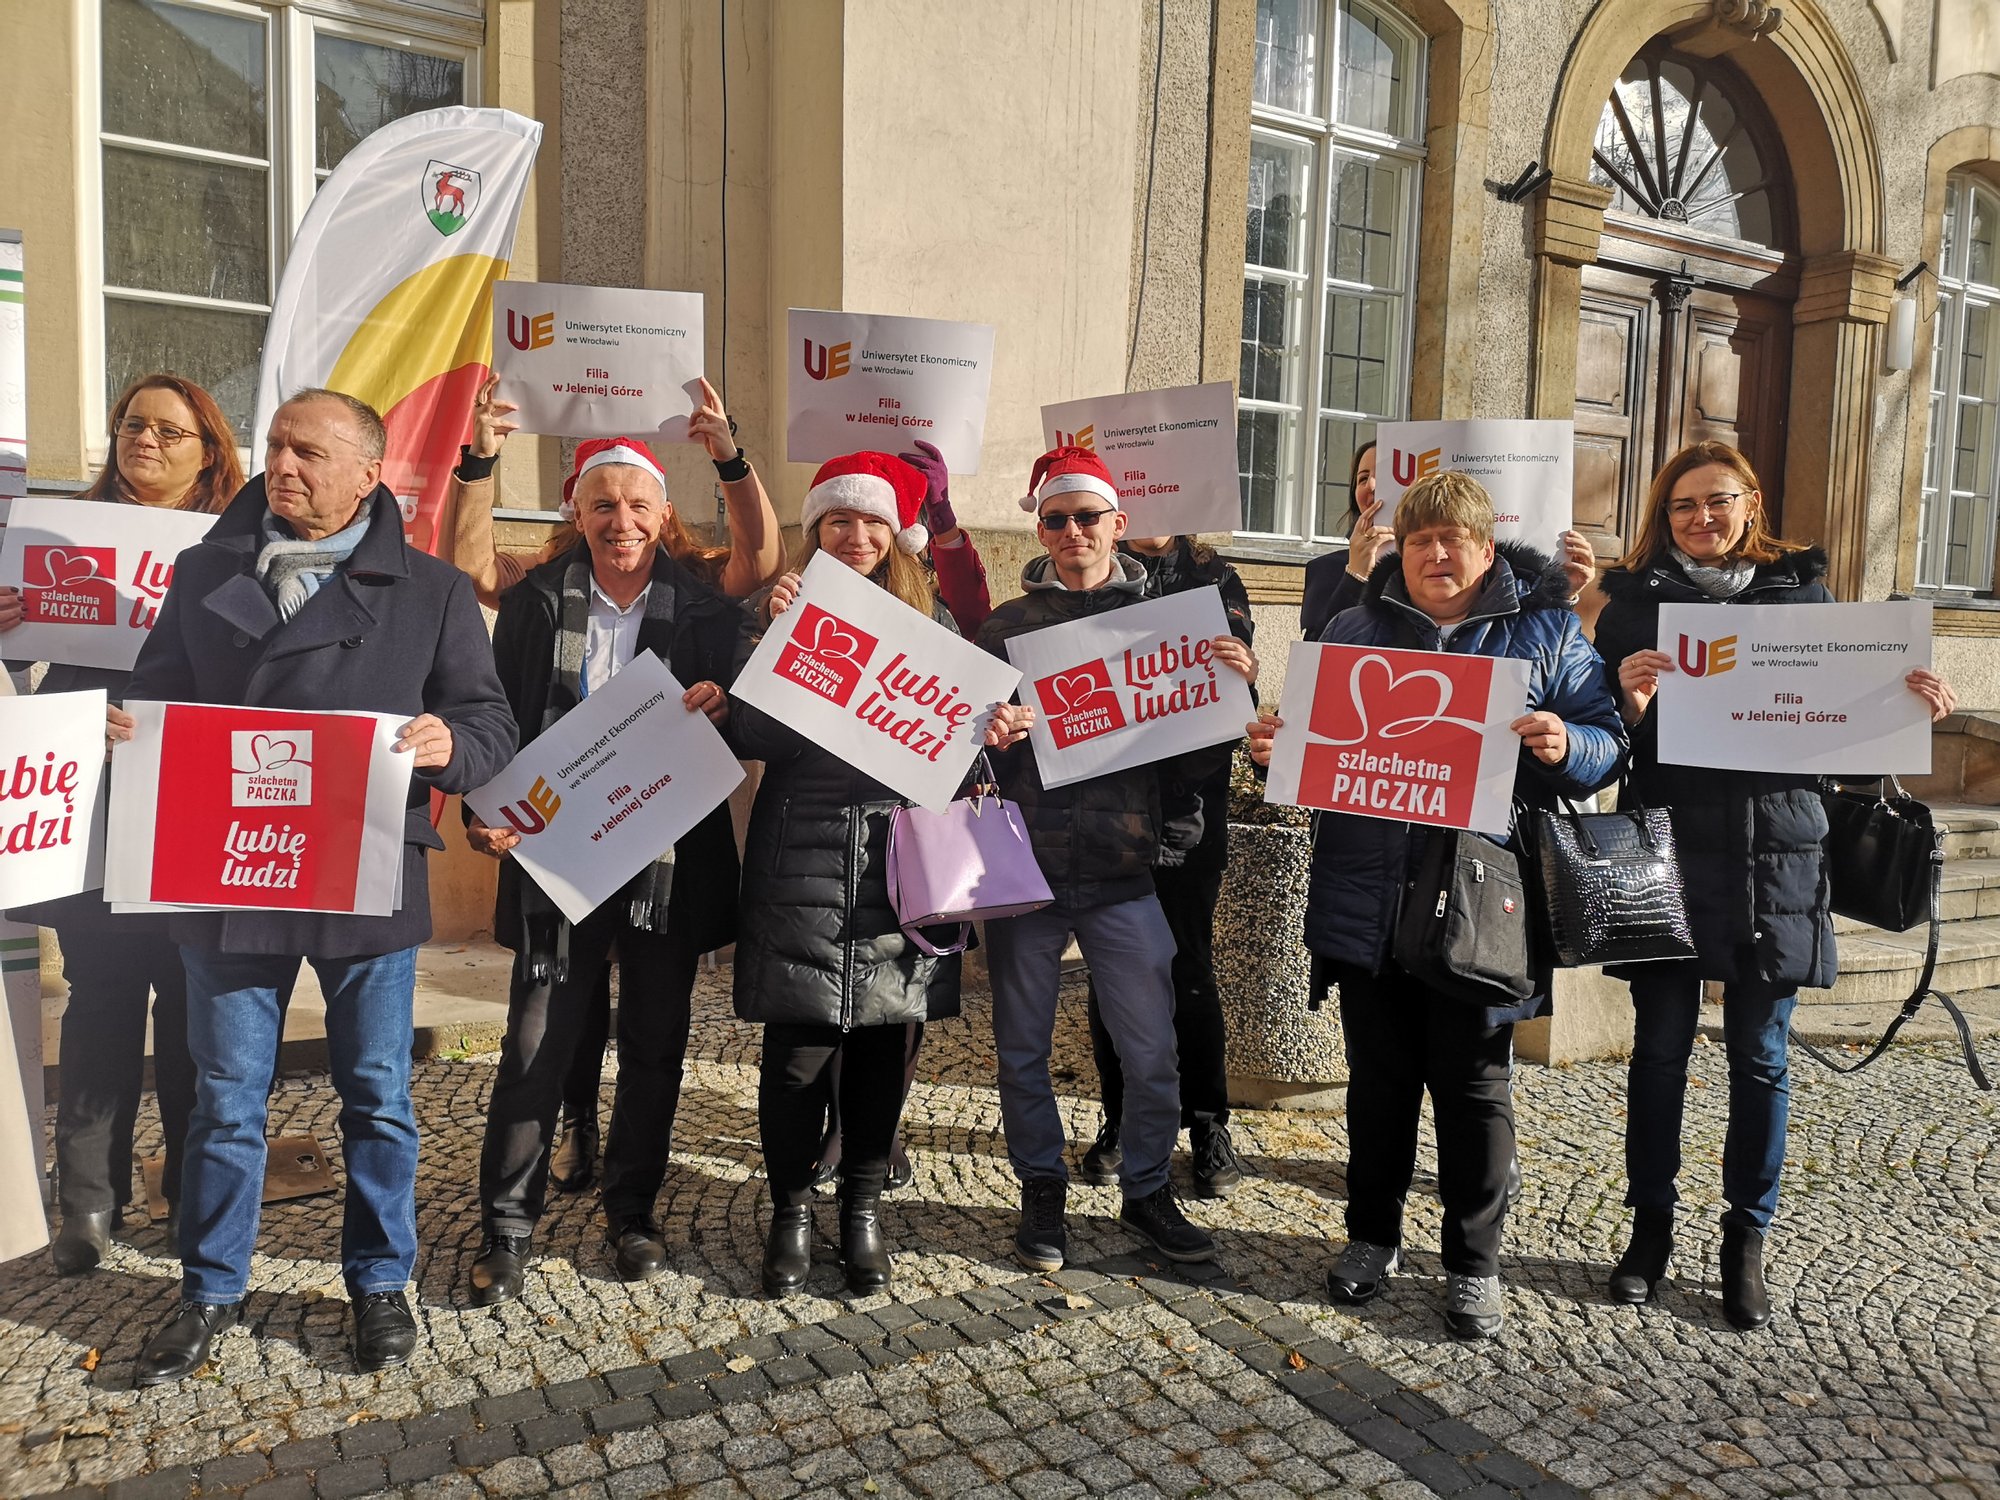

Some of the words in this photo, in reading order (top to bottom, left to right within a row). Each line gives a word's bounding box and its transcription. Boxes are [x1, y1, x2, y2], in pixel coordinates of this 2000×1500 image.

[507, 308, 555, 351] UE
[565, 321, 623, 334] Uniwersytet
[625, 324, 687, 338] Ekonomiczny
[579, 336, 620, 346] Wrocławiu
[804, 337, 851, 381] UE
[862, 350, 918, 363] Uniwersytet
[920, 354, 978, 370] Ekonomiczny
[586, 368, 609, 379] Filia
[875, 366, 914, 376] Wrocławiu
[552, 383, 563, 392] w
[565, 382, 608, 397] Jeleniej
[611, 384, 643, 397] Górze
[878, 398, 901, 409] Filia
[846, 413, 856, 422] w
[858, 412, 899, 427] Jeleniej
[901, 415, 933, 428] Górze
[1103, 424, 1157, 438] Uniwersytet
[1159, 417, 1219, 432] Ekonomiczny
[1105, 443, 1116, 451] we
[1116, 439, 1155, 450] Wrocławiu
[1392, 447, 1441, 487] UE
[1451, 453, 1506, 464] Uniwersytet
[1507, 453, 1559, 463] Ekonomiczny
[1124, 470, 1146, 482] Filia
[1464, 467, 1502, 475] Wrocławiu
[1116, 485, 1145, 498] leniej
[1148, 482, 1180, 495] Górze
[41, 591, 100, 605] szlachetna
[39, 602, 99, 621] PACZKA
[1678, 633, 1738, 678] UE
[1751, 642, 1823, 655] Uniwersytet
[1826, 641, 1909, 653] Ekonomiczny
[797, 651, 844, 685] szlachetna
[1124, 635, 1214, 690] Lubię
[1751, 660, 1765, 668] we
[1768, 658, 1819, 668] Wrocławiu
[788, 661, 839, 698] PACZKA
[875, 652, 972, 733] Lubię
[1134, 671, 1221, 724] ludzi
[1774, 693, 1803, 705] Filia
[855, 691, 952, 762] ludzi
[1062, 706, 1108, 726] szlachetna
[1731, 711, 1744, 721] w
[1746, 709, 1801, 725] Jeleniej
[1805, 710, 1847, 723] Górze
[557, 735, 611, 780] Uniwersytet
[608, 690, 665, 738] Ekonomiczny
[1064, 715, 1112, 740] PACZKA
[569, 779, 582, 791] we
[579, 749, 617, 783] Wrocławiu
[1338, 748, 1452, 782] szlachetna
[0, 752, 79, 803] bię
[248, 774, 298, 787] szlachetna
[246, 786, 297, 801] PACZKA
[606, 783, 632, 805] Filia
[1331, 773, 1446, 817] PACZKA
[498, 775, 562, 835] UE
[590, 831, 603, 842] w
[602, 798, 643, 834] Jeleniej
[640, 772, 672, 800] Górze
[0, 804, 74, 855] dzi
[223, 821, 307, 861] Lubię
[220, 858, 301, 889] ludzi
